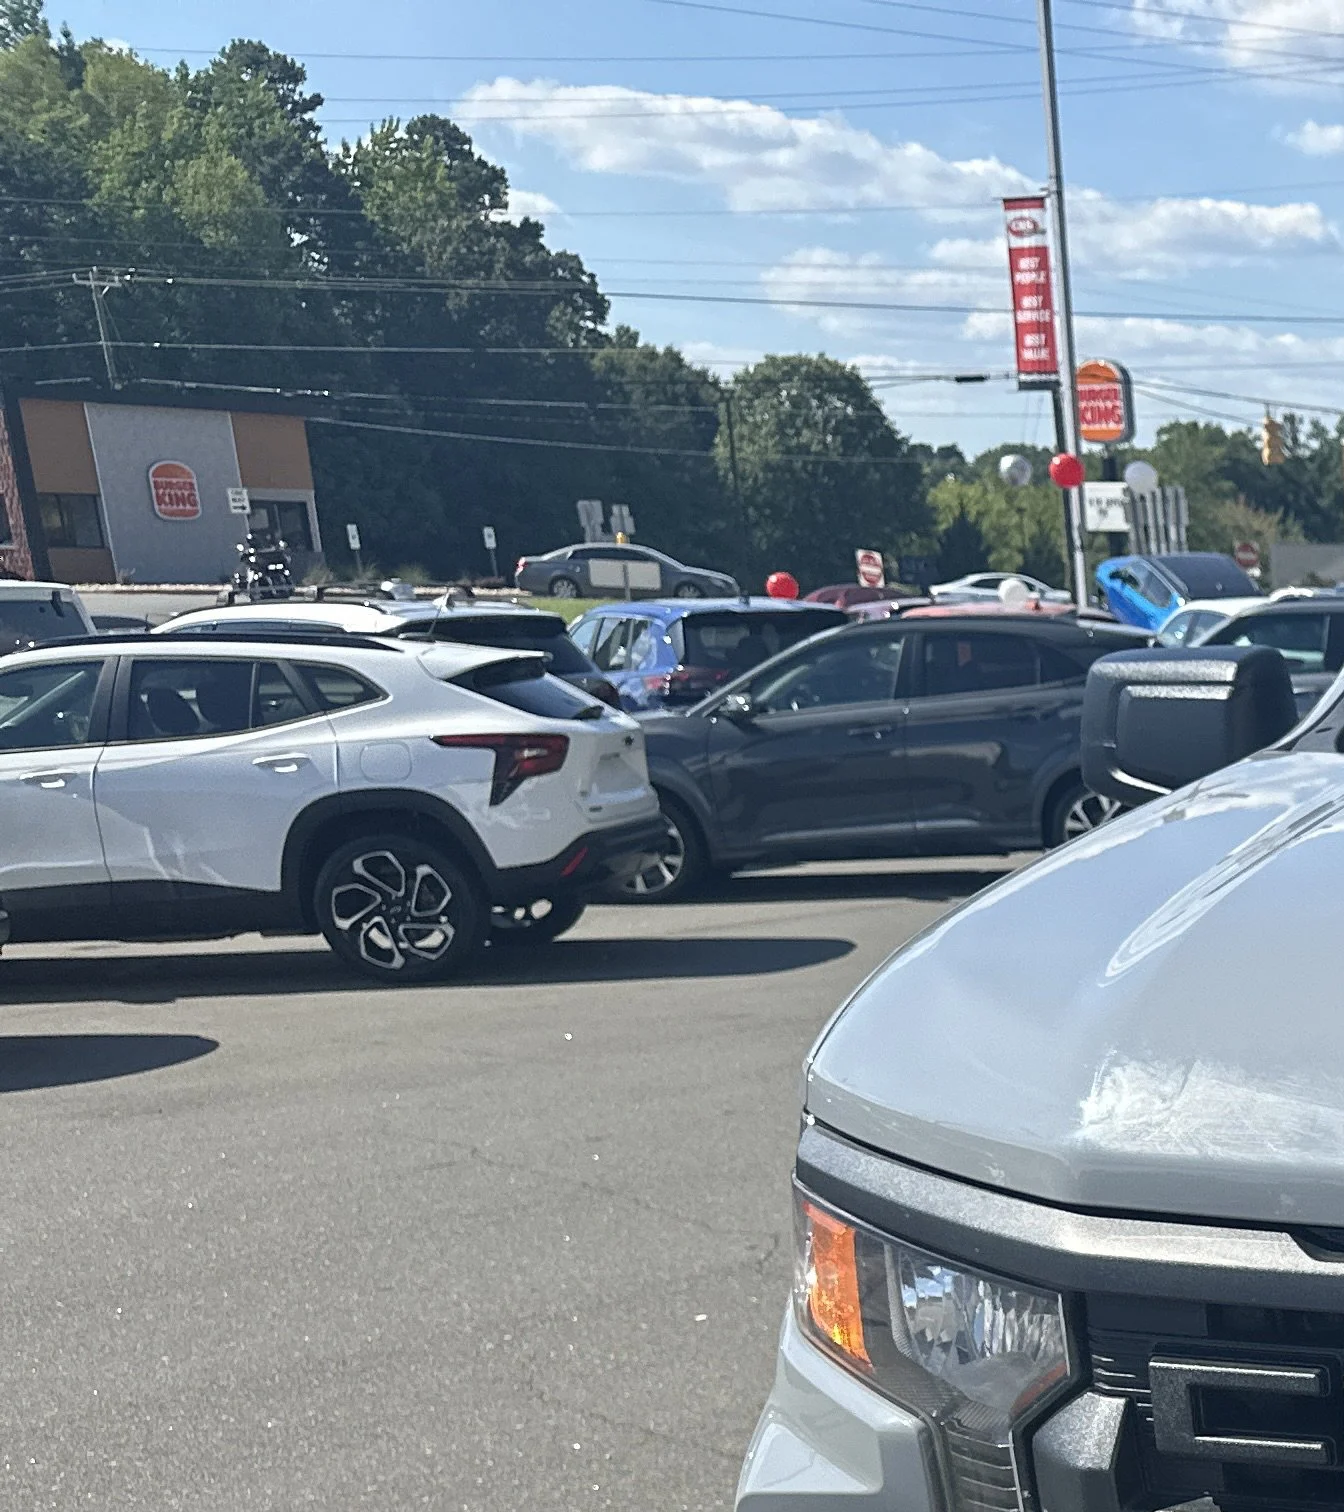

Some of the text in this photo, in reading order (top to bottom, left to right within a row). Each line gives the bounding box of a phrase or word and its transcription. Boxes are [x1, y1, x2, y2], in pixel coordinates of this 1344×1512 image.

[1079, 404, 1122, 425] KING
[153, 479, 197, 491] BURGER
[155, 490, 199, 508] KING
